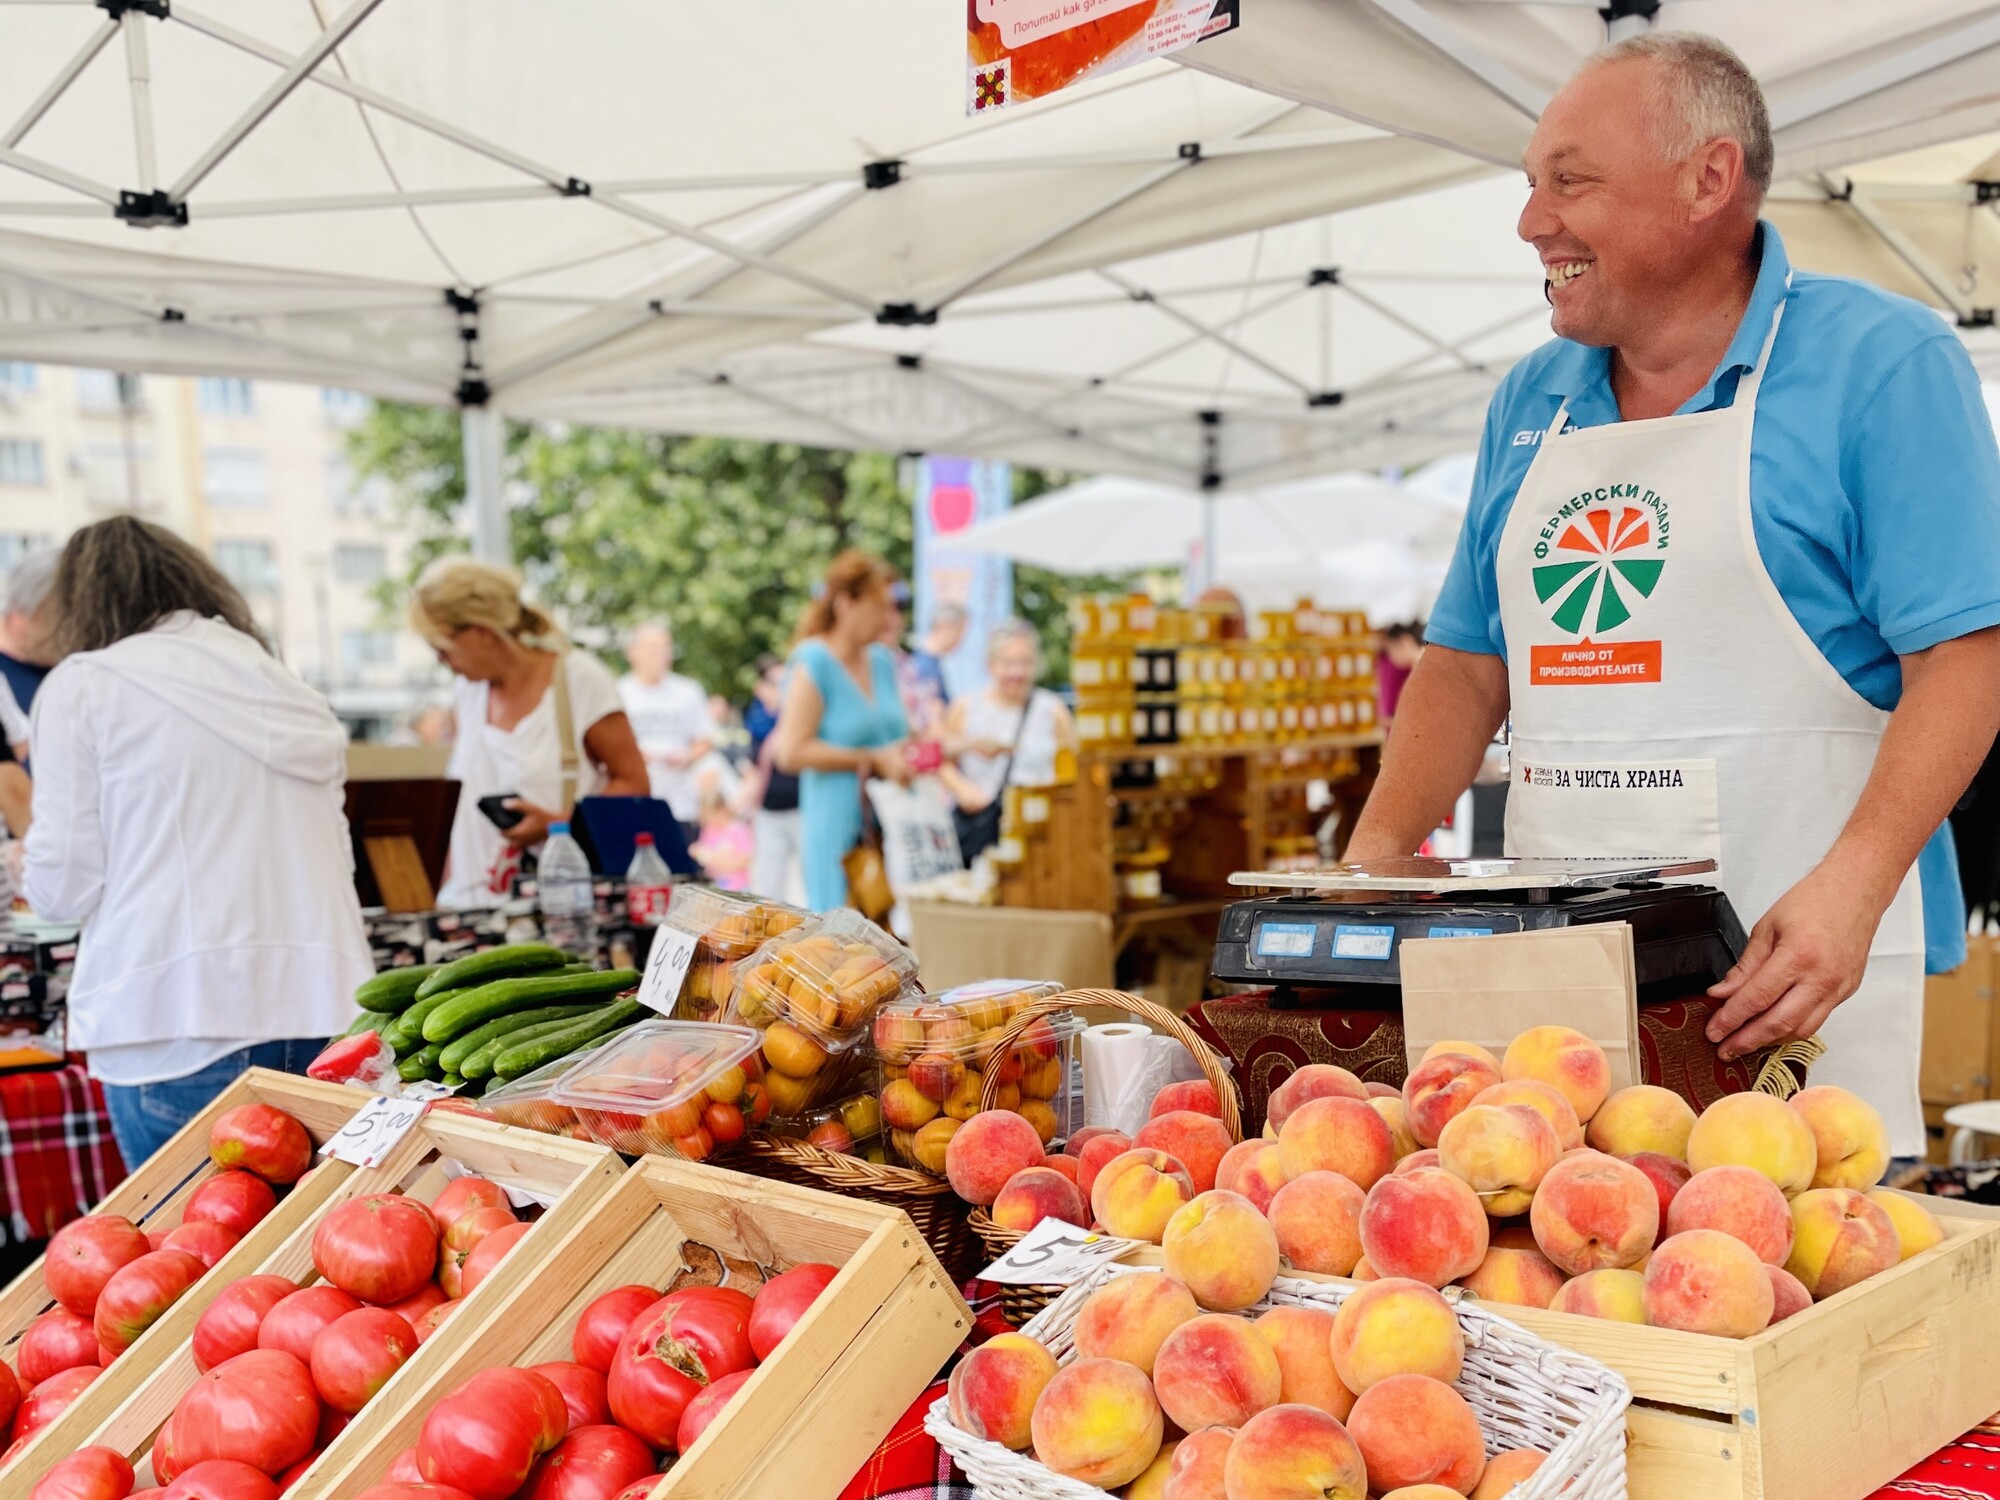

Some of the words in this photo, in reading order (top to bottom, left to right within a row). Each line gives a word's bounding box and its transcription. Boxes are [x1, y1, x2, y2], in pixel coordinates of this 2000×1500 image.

[1534, 483, 1639, 559] ФЕРМЕРСКИ
[1641, 489, 1670, 550] ПАЗАРИ
[1561, 651, 1595, 662] ЛИЧНО
[1598, 650, 1615, 661] ОТ
[1539, 664, 1646, 678] ПРОИЗВОДИТЕЛИТЕ
[1555, 769, 1571, 787] ЗА
[1575, 770, 1621, 788] ЧИСТА
[1626, 769, 1684, 788] ХРАНА
